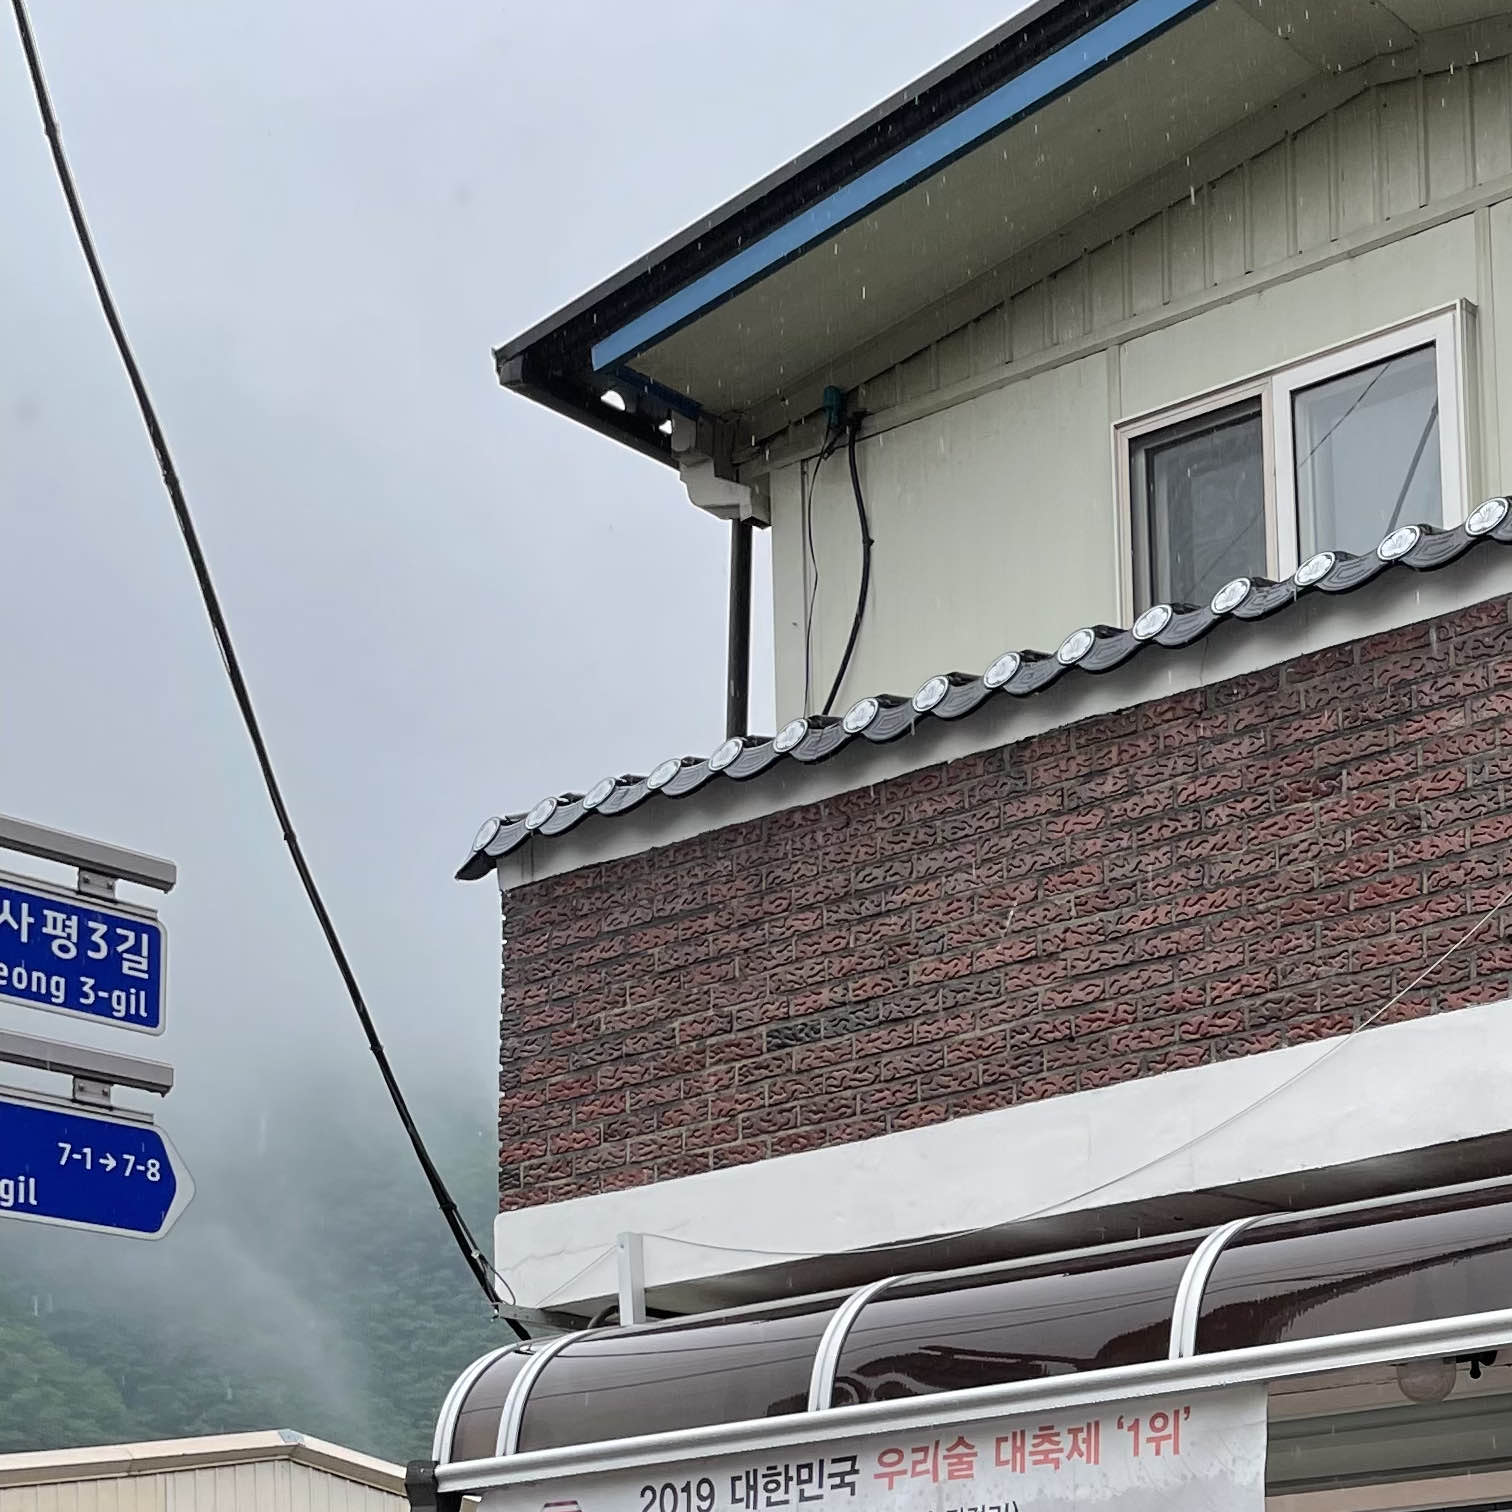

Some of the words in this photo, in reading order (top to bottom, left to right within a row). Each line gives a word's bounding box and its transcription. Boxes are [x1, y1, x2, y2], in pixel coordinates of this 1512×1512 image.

[80, 976, 148, 1018] 3-gil
[730, 1455, 861, 1512] 대한민국
[872, 1435, 979, 1490] 우리술
[994, 1420, 1101, 1474] 대축제
